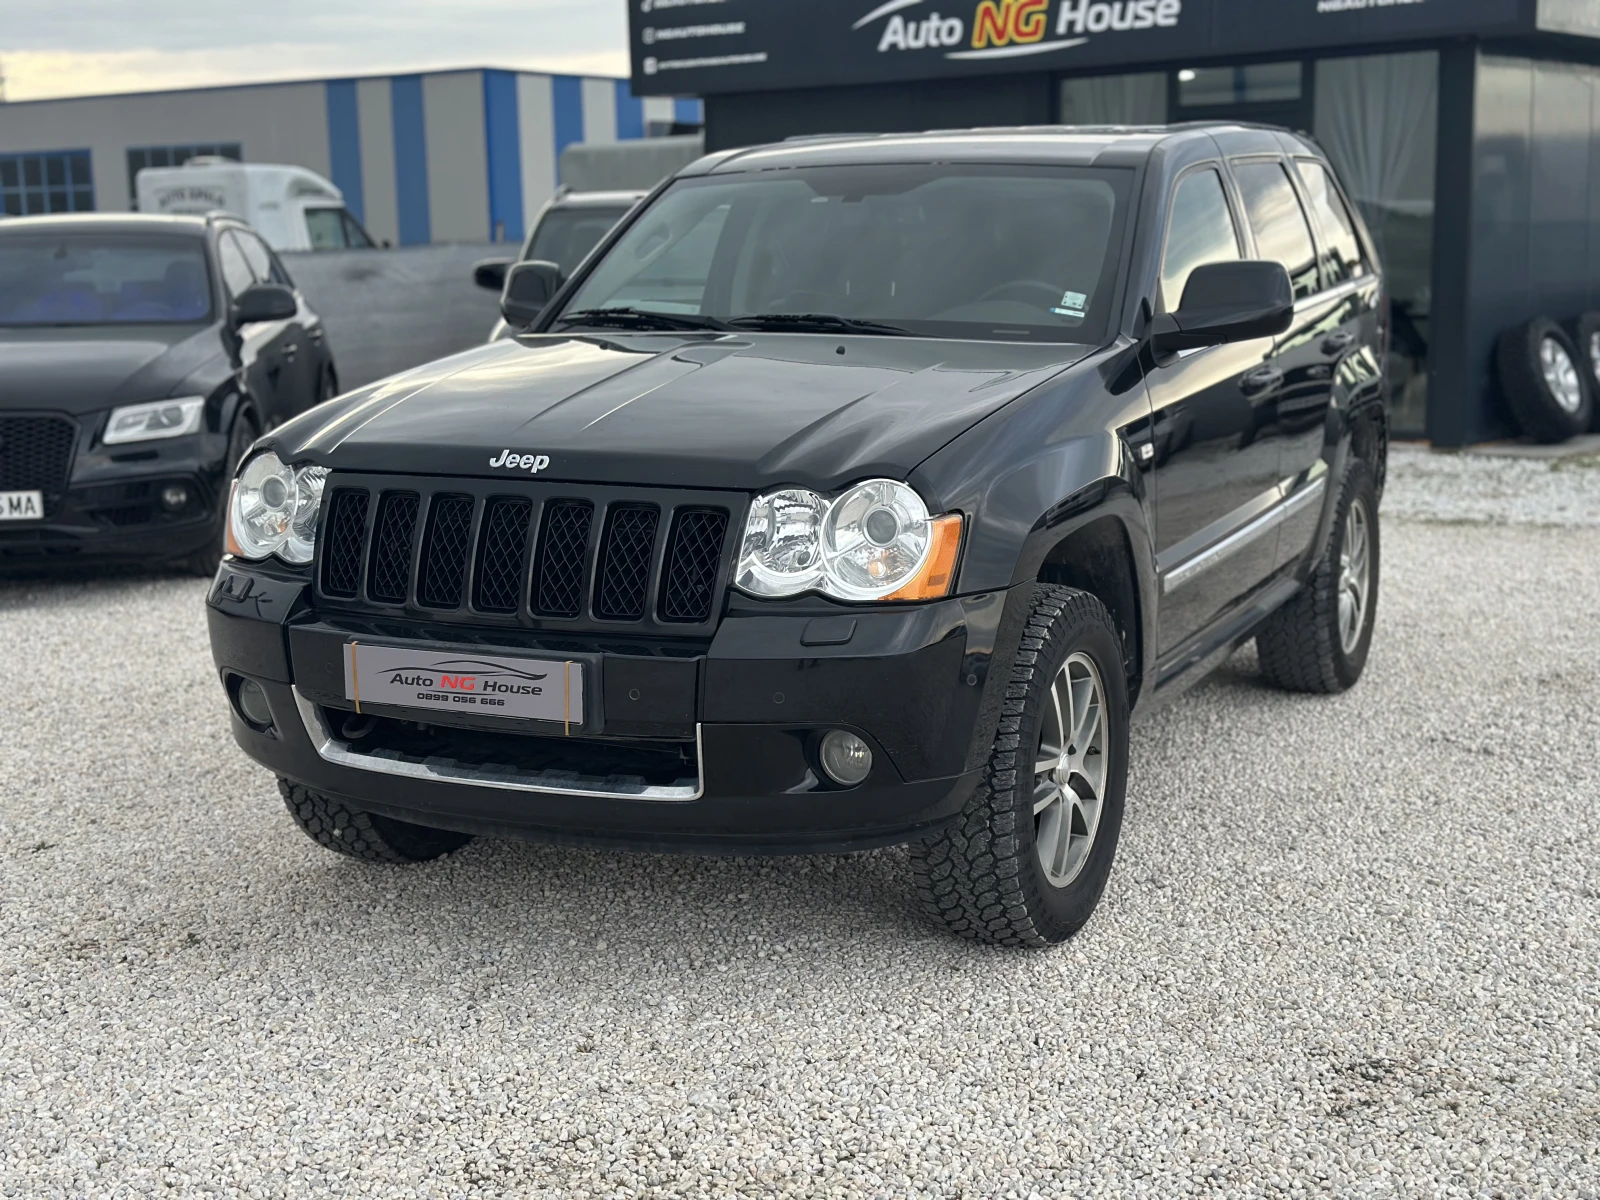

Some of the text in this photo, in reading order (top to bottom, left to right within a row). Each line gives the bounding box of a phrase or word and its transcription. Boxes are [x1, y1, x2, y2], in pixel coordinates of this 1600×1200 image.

[877, 0, 1182, 52] Auto NG House
[489, 449, 550, 474] Jeep
[390, 673, 543, 696] Auto NG House
[417, 692, 505, 706] 0899 056 666
